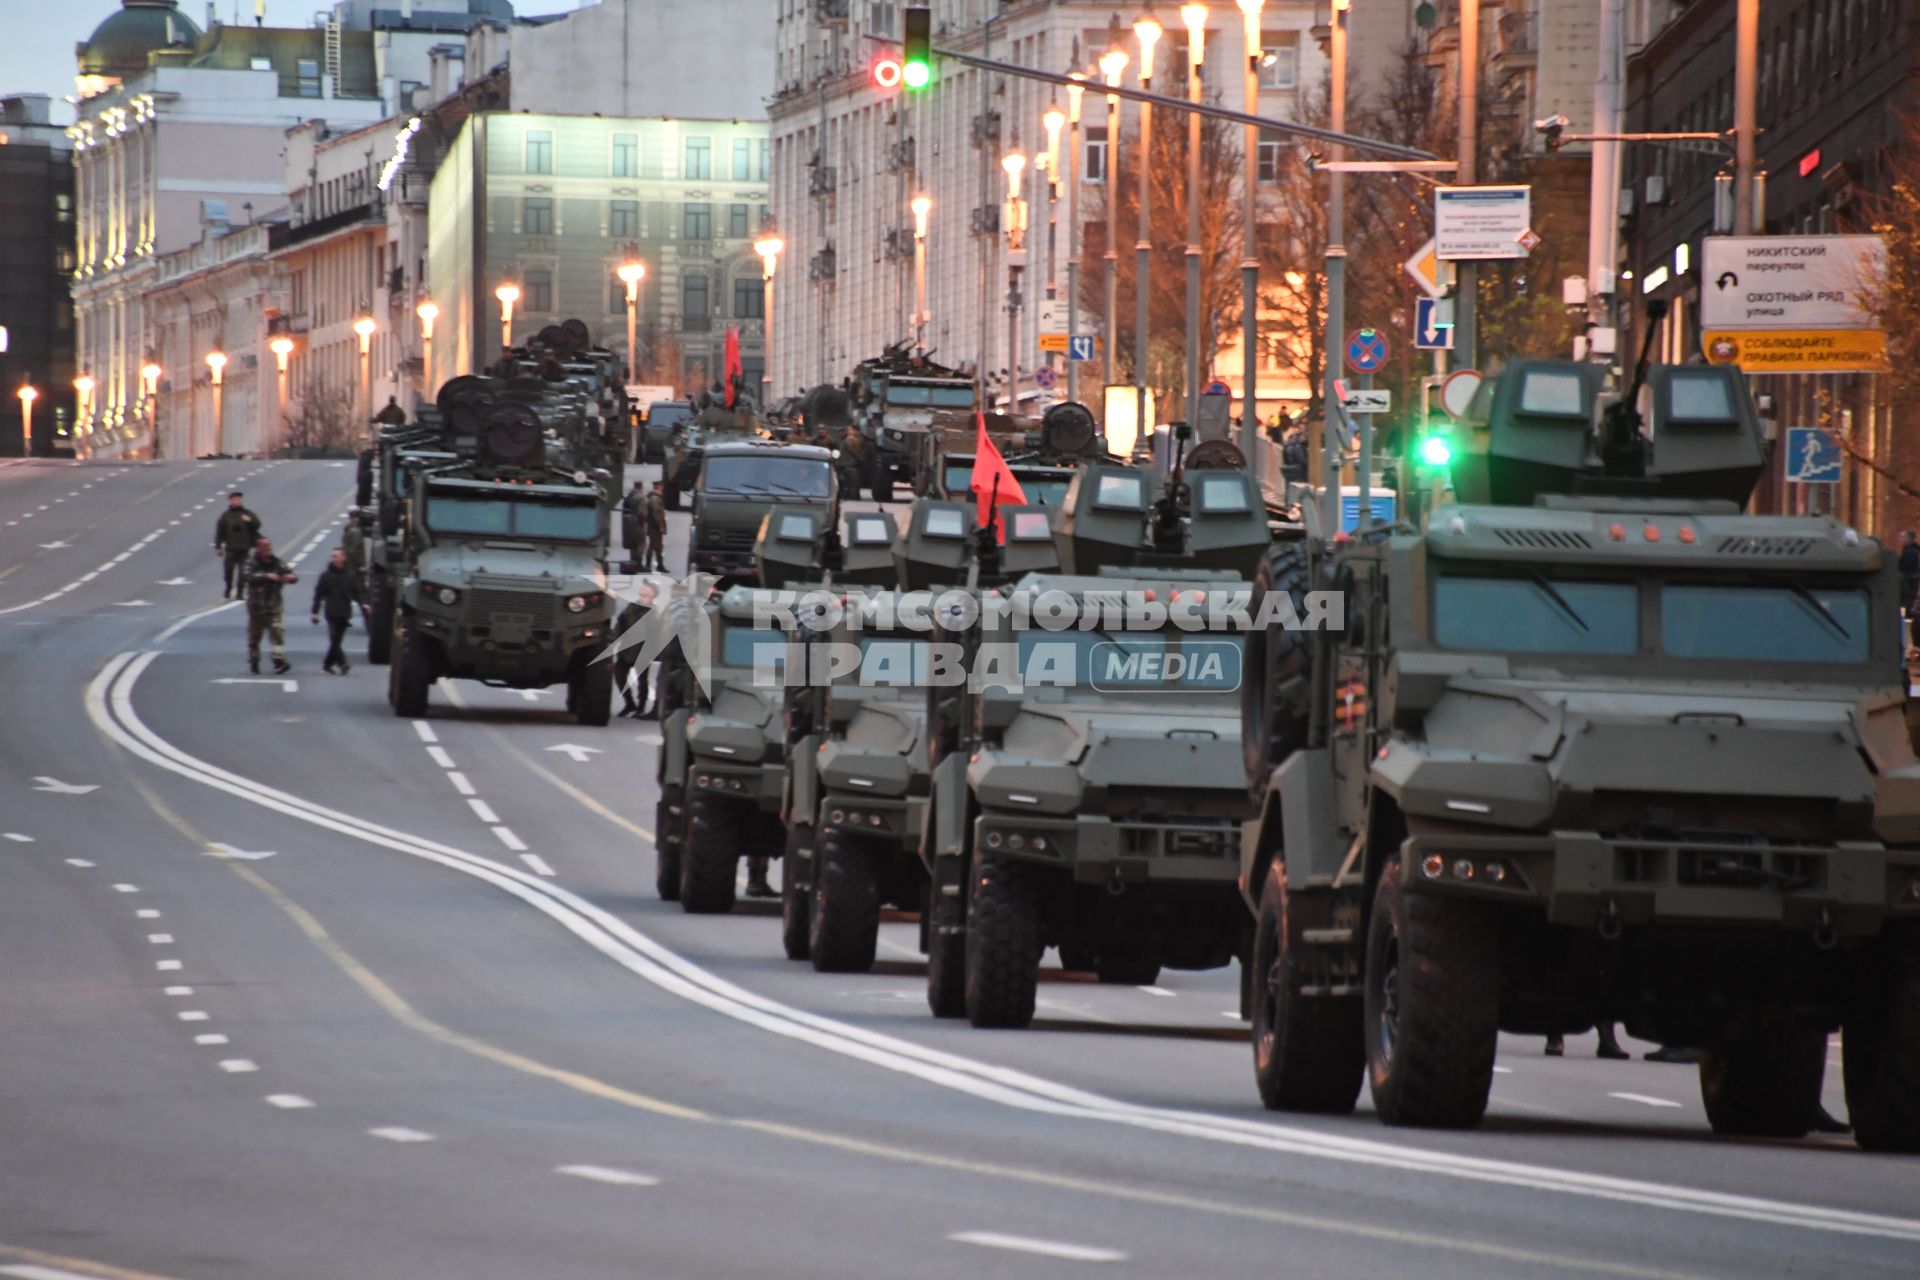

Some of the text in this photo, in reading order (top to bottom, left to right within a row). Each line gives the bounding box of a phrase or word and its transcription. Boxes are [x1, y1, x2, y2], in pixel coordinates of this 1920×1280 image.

[1747, 245, 1827, 257] НИКИТСКИЙ
[1746, 262, 1806, 272] переулок
[1746, 290, 1845, 303] ОХОТНЫЙ РЯД
[1746, 307, 1785, 318] улица
[1744, 337, 1837, 349] СОБЛЮДАЙТЕ
[1743, 352, 1804, 363] ПРАВИЛА
